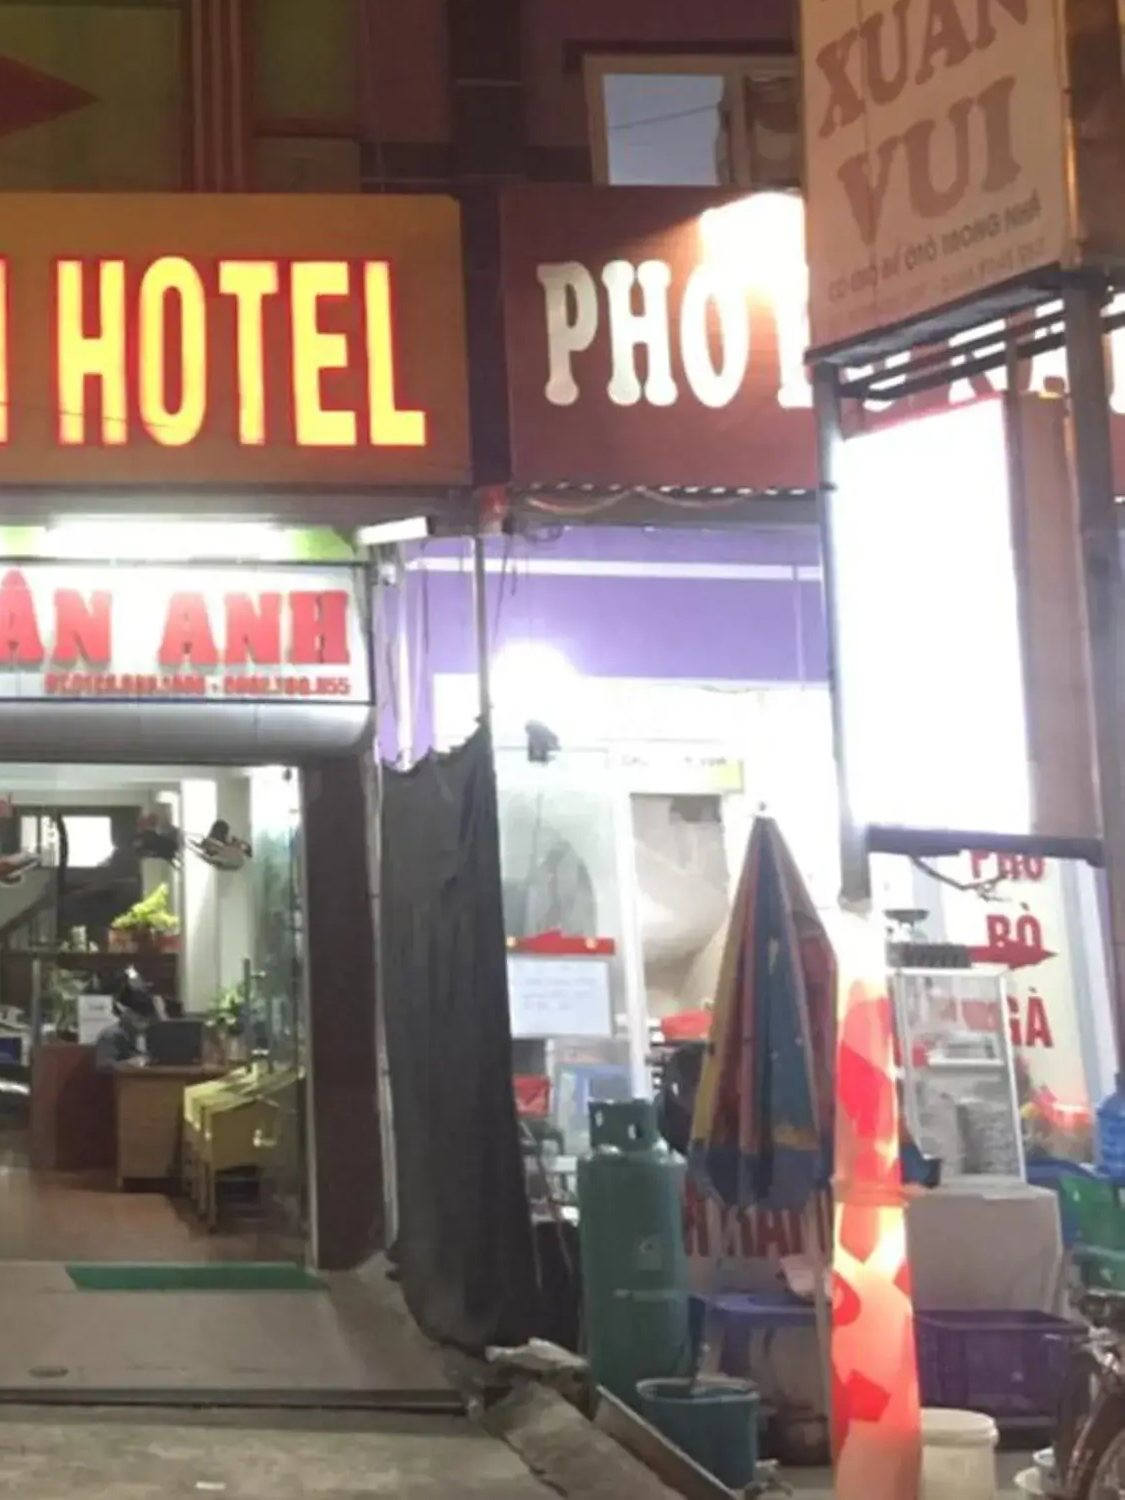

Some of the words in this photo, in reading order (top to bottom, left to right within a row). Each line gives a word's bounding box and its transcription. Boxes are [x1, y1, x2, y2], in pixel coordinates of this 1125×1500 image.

[837, 75, 1022, 245] VUI
[55, 254, 428, 448] HOTEL
[157, 590, 350, 665] ANH
